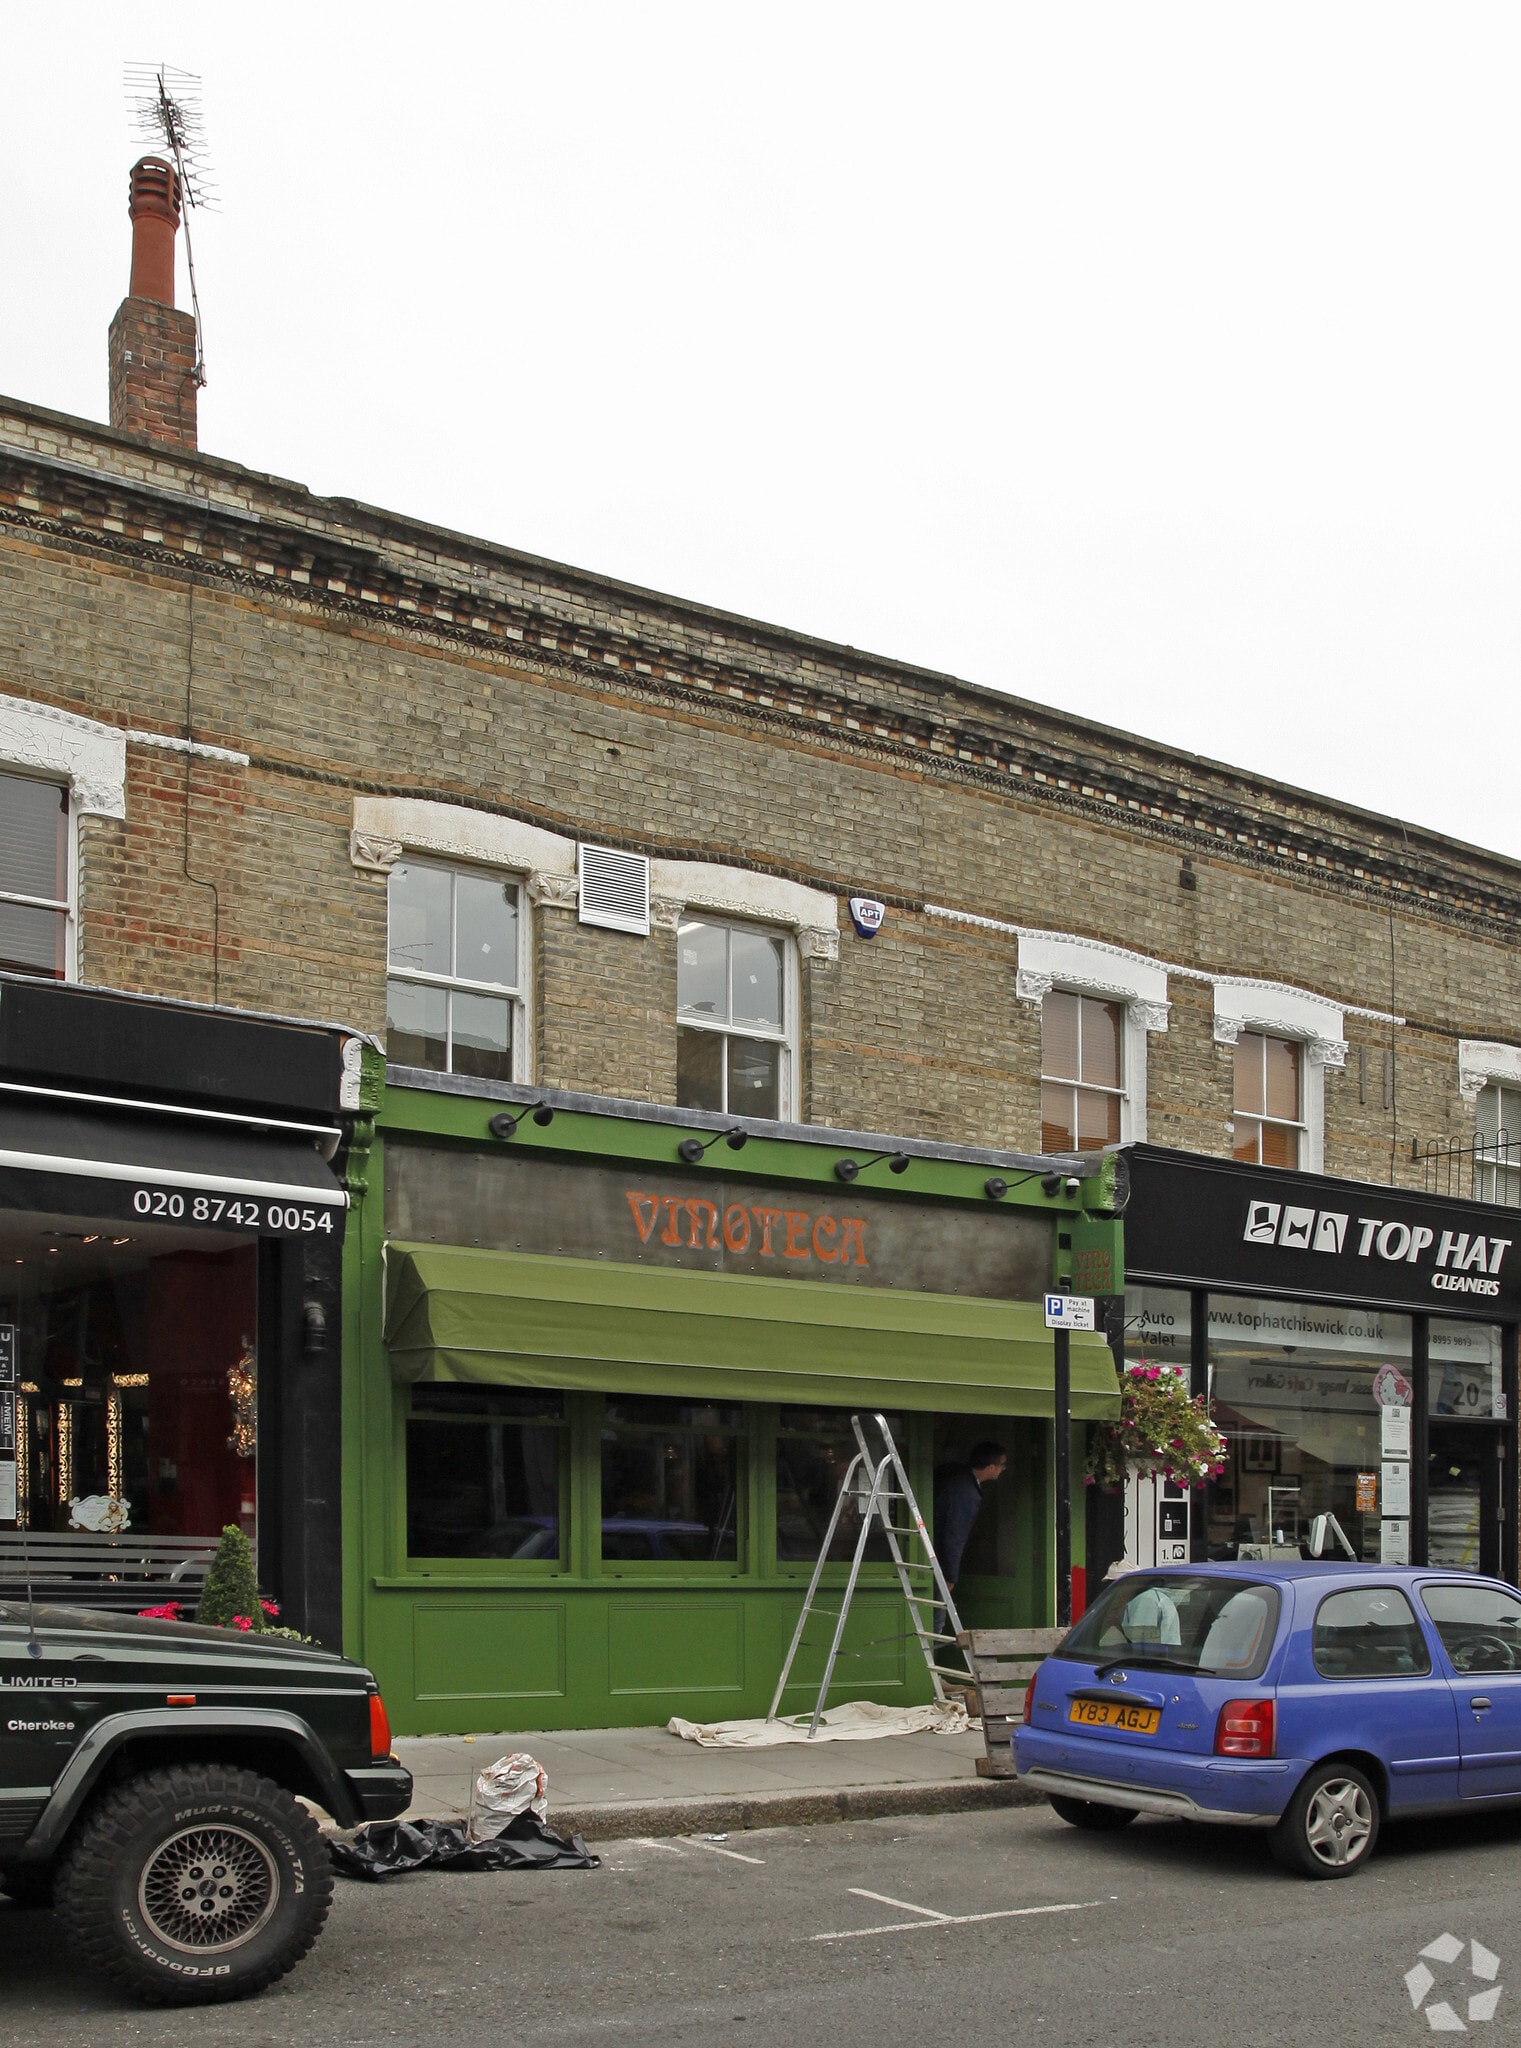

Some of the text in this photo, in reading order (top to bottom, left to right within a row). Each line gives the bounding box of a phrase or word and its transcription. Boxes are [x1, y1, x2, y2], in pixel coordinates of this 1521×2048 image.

[860, 908, 880, 919] APT
[133, 1190, 334, 1234] 020 8742 0054
[625, 1191, 869, 1267] VINOTECA
[1357, 1217, 1513, 1274] TOP HAT
[1075, 1271, 1112, 1293] TECA
[1430, 1272, 1501, 1297] CLEANERS
[1050, 1299, 1061, 1315] P
[1068, 1298, 1079, 1307] Pay
[1051, 1319, 1072, 1328] Display
[1142, 1310, 1175, 1326] Auto
[1141, 1331, 1176, 1347] Valet
[1453, 1381, 1480, 1407] 20
[0, 1676, 77, 1687] LIMITED
[7, 1720, 75, 1731] Cherokee
[1077, 1703, 1109, 1722] Y83
[1115, 1710, 1153, 1730] AGJ
[174, 1804, 305, 1894] Mud-Terrain T/A
[121, 1908, 231, 1977] BFGoodrich
